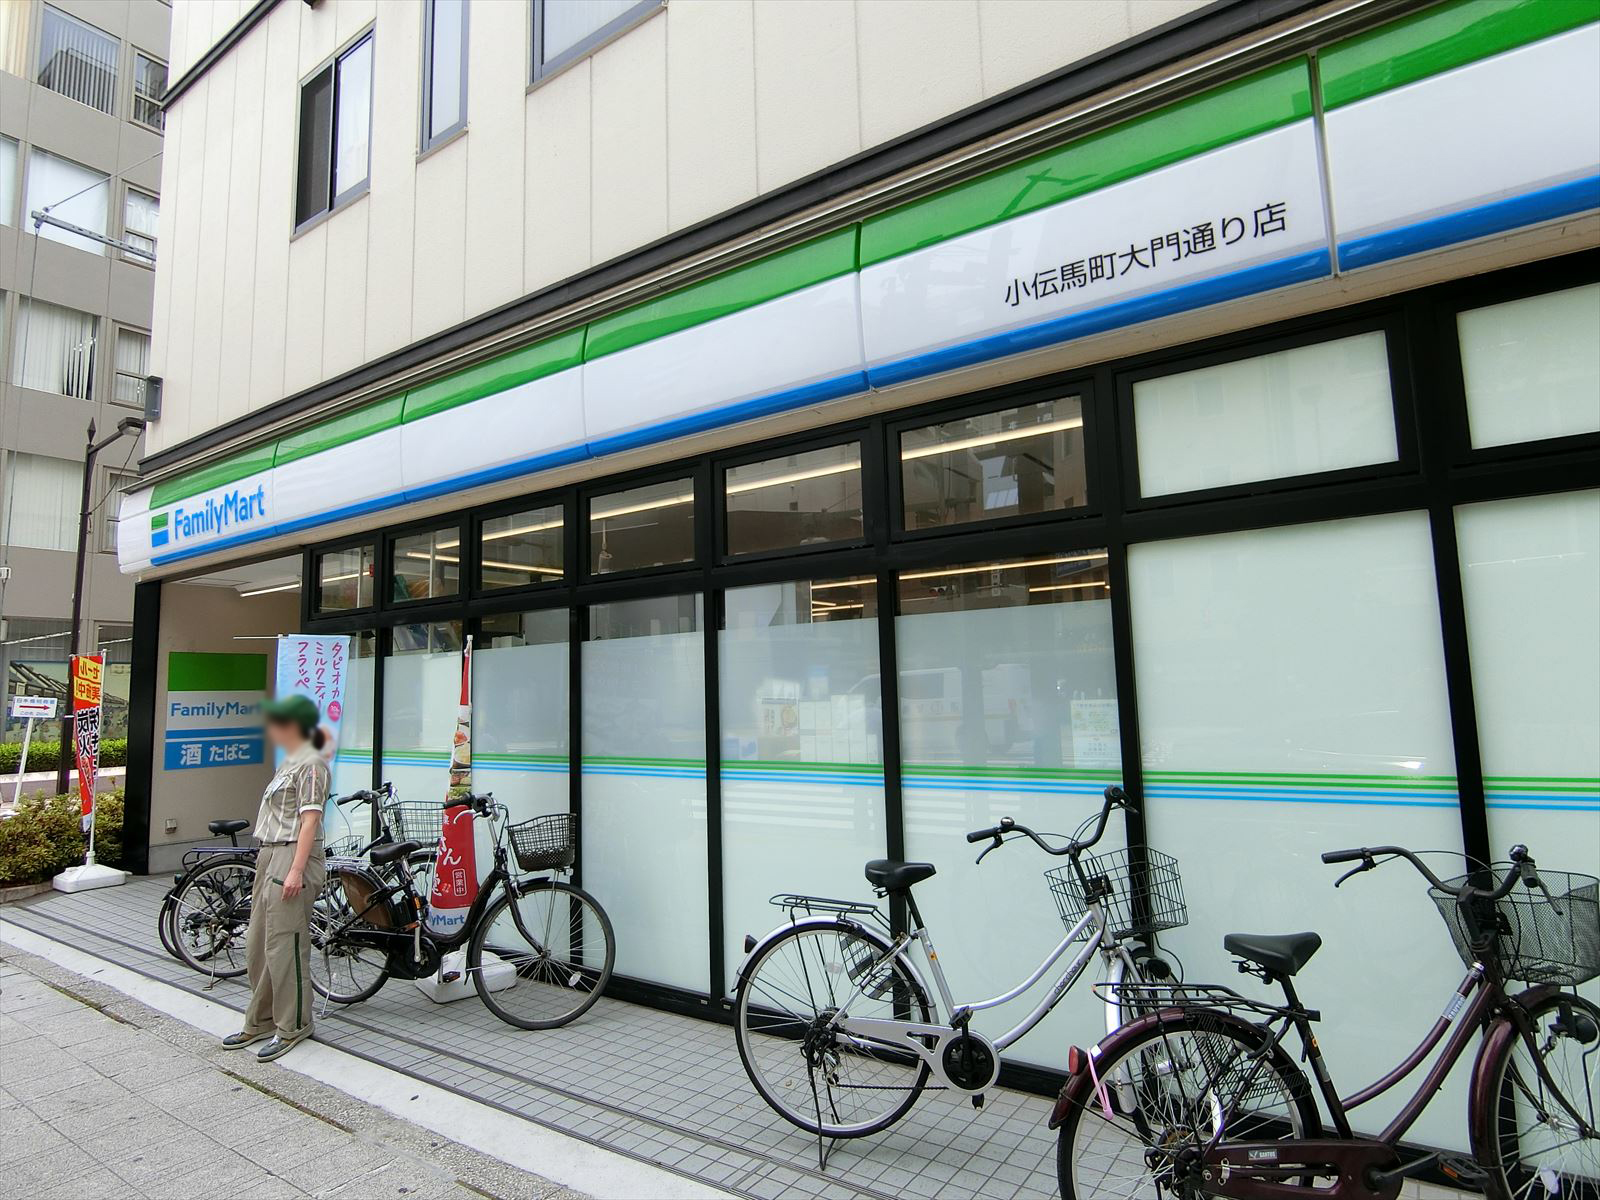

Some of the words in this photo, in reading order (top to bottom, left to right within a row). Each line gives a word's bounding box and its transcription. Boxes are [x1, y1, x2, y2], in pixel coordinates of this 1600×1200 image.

[1005, 202, 1287, 307] 小伝馬町大門通り店
[174, 484, 265, 540] FamilyMart
[294, 641, 310, 689] フラッペ
[314, 641, 328, 711] ミルクティー
[331, 641, 343, 699] タピオカ
[180, 743, 203, 766] 酒
[208, 743, 251, 762] たばこ
[454, 871, 465, 895] 営業中
